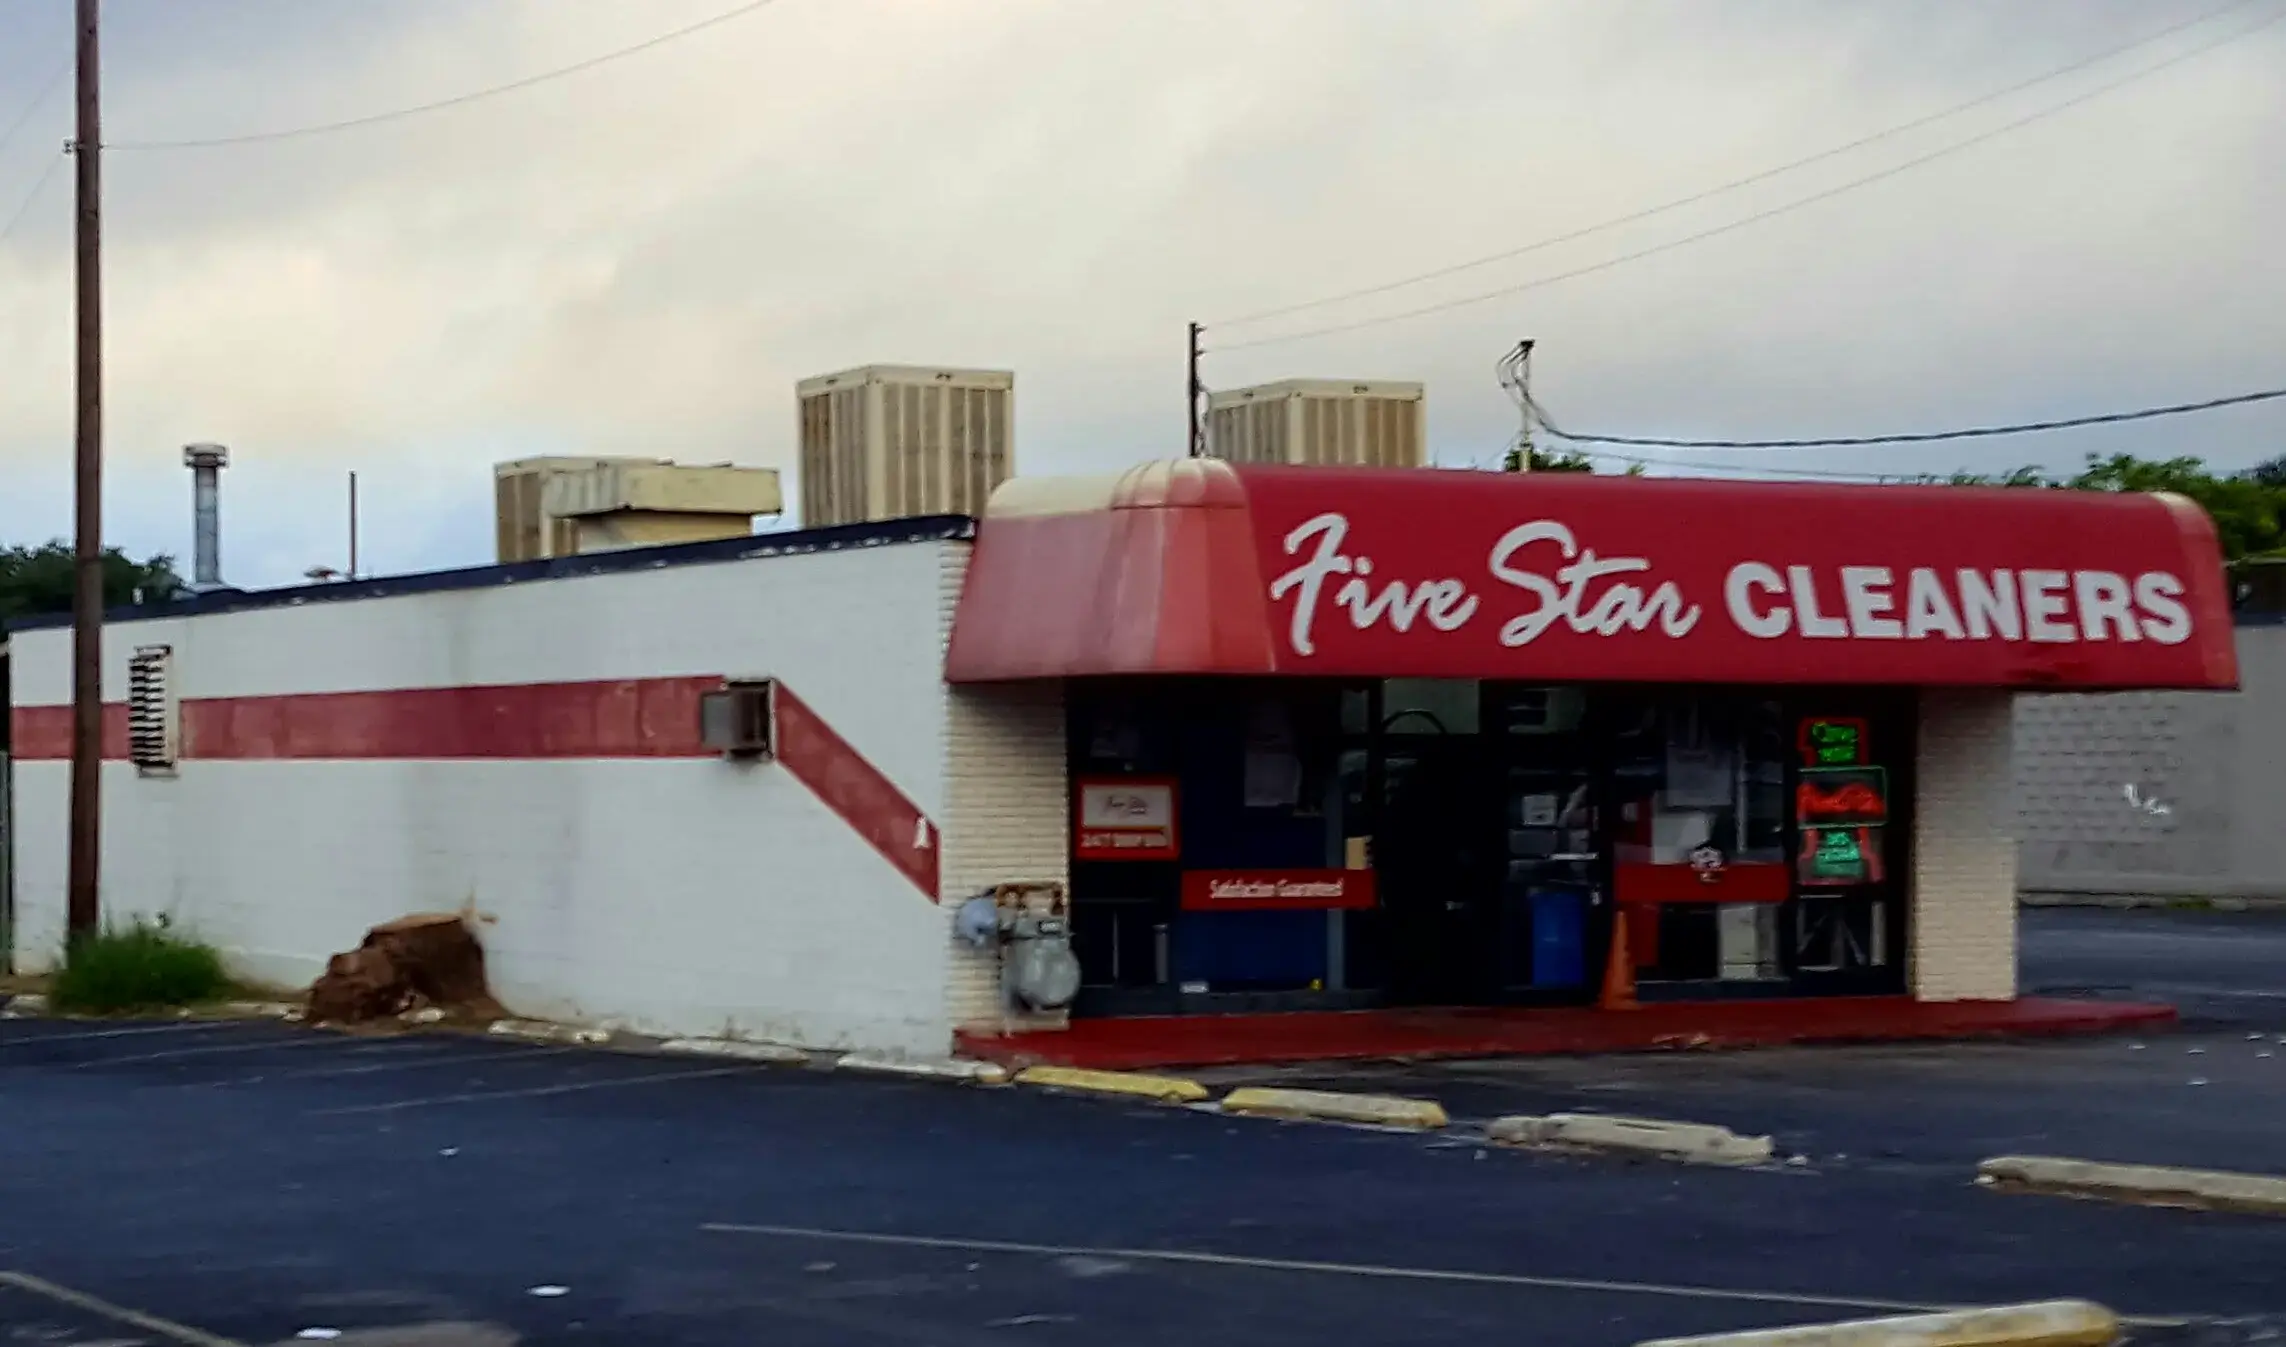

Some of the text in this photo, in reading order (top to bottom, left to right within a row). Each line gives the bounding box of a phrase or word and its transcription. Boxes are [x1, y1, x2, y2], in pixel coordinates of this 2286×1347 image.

[1271, 512, 2194, 656] Five Star CLEANERS
